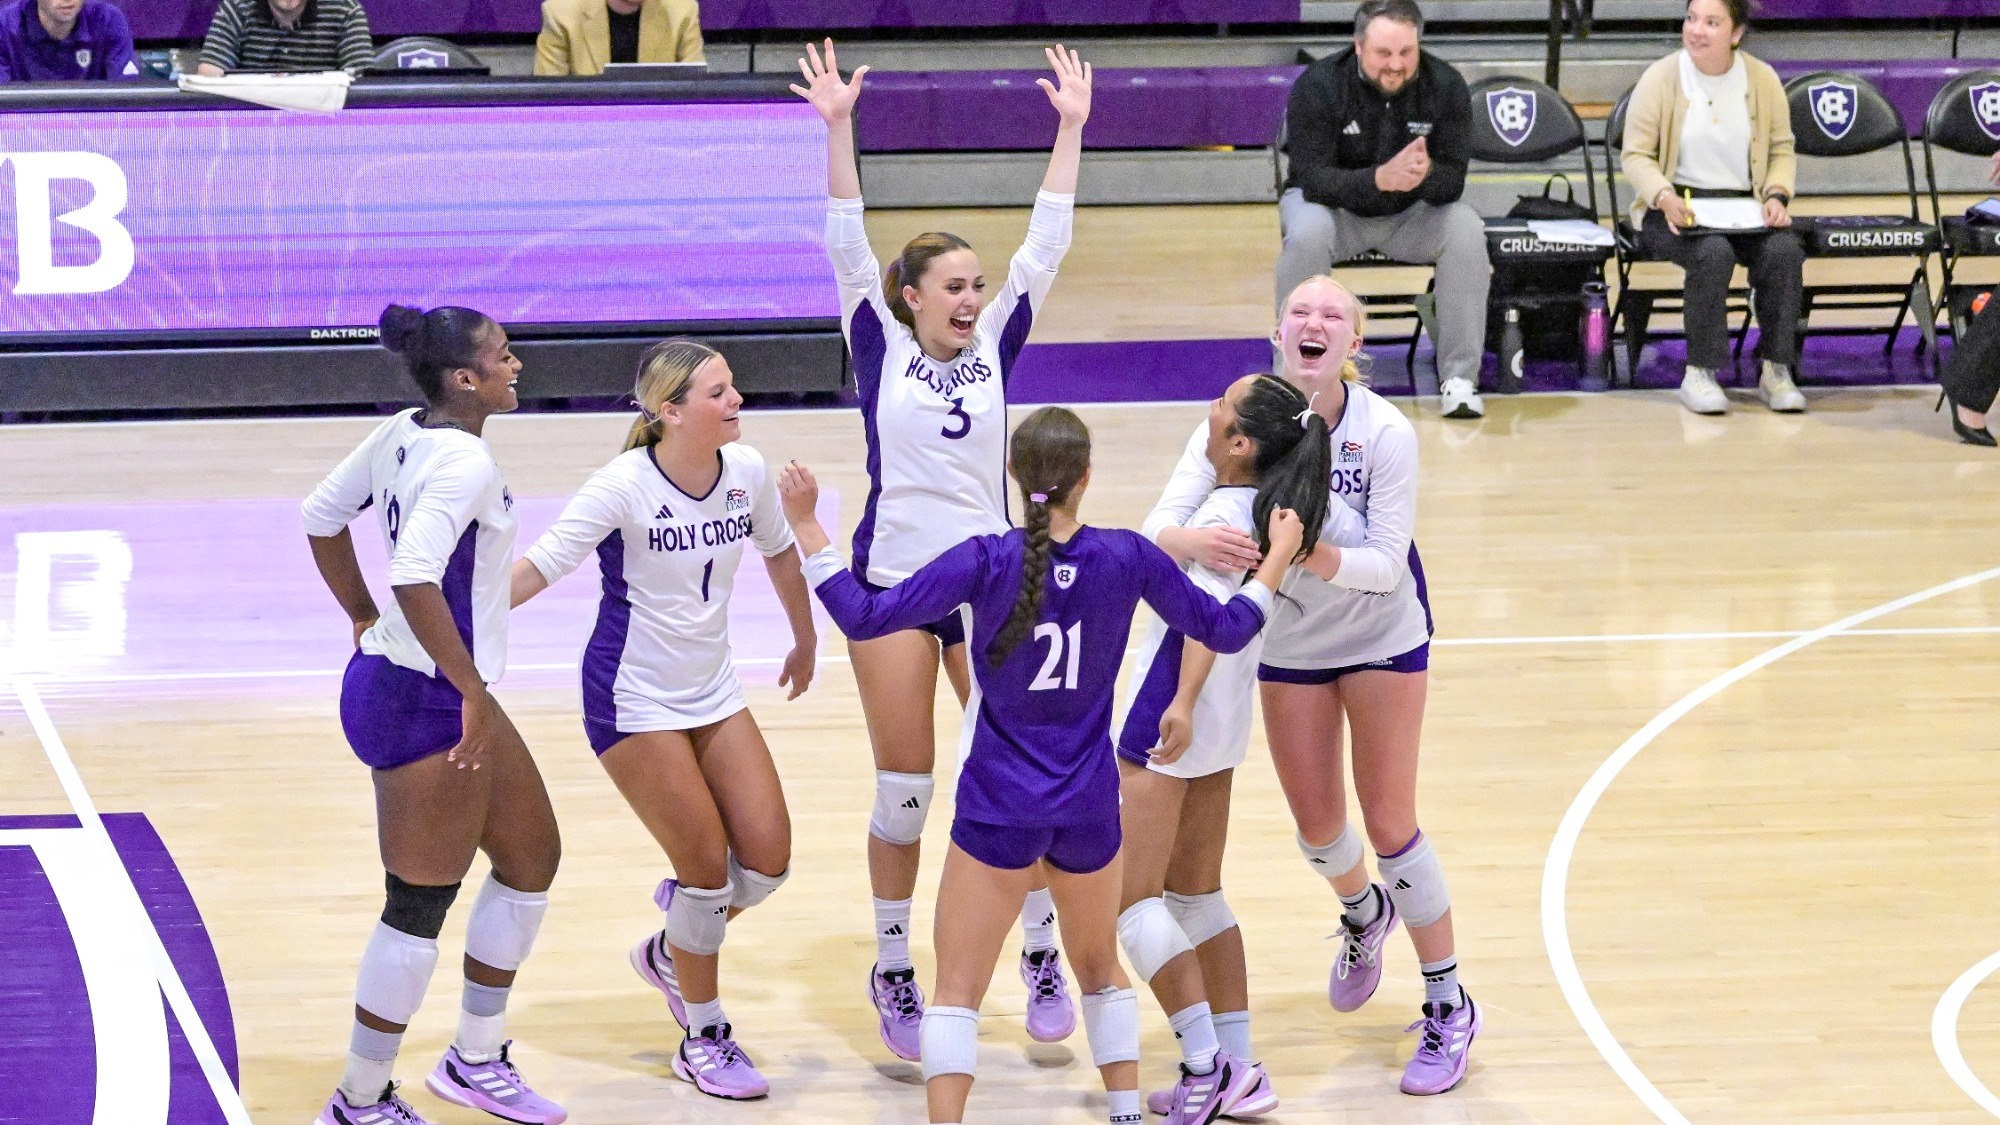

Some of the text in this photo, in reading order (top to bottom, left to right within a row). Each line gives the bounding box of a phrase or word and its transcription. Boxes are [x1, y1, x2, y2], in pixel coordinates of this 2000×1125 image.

[1828, 231, 1925, 247] CRUSADERS
[940, 396, 972, 440] 3
[648, 524, 696, 552] HOLY
[701, 557, 714, 603] 1
[1027, 619, 1082, 691] 21
